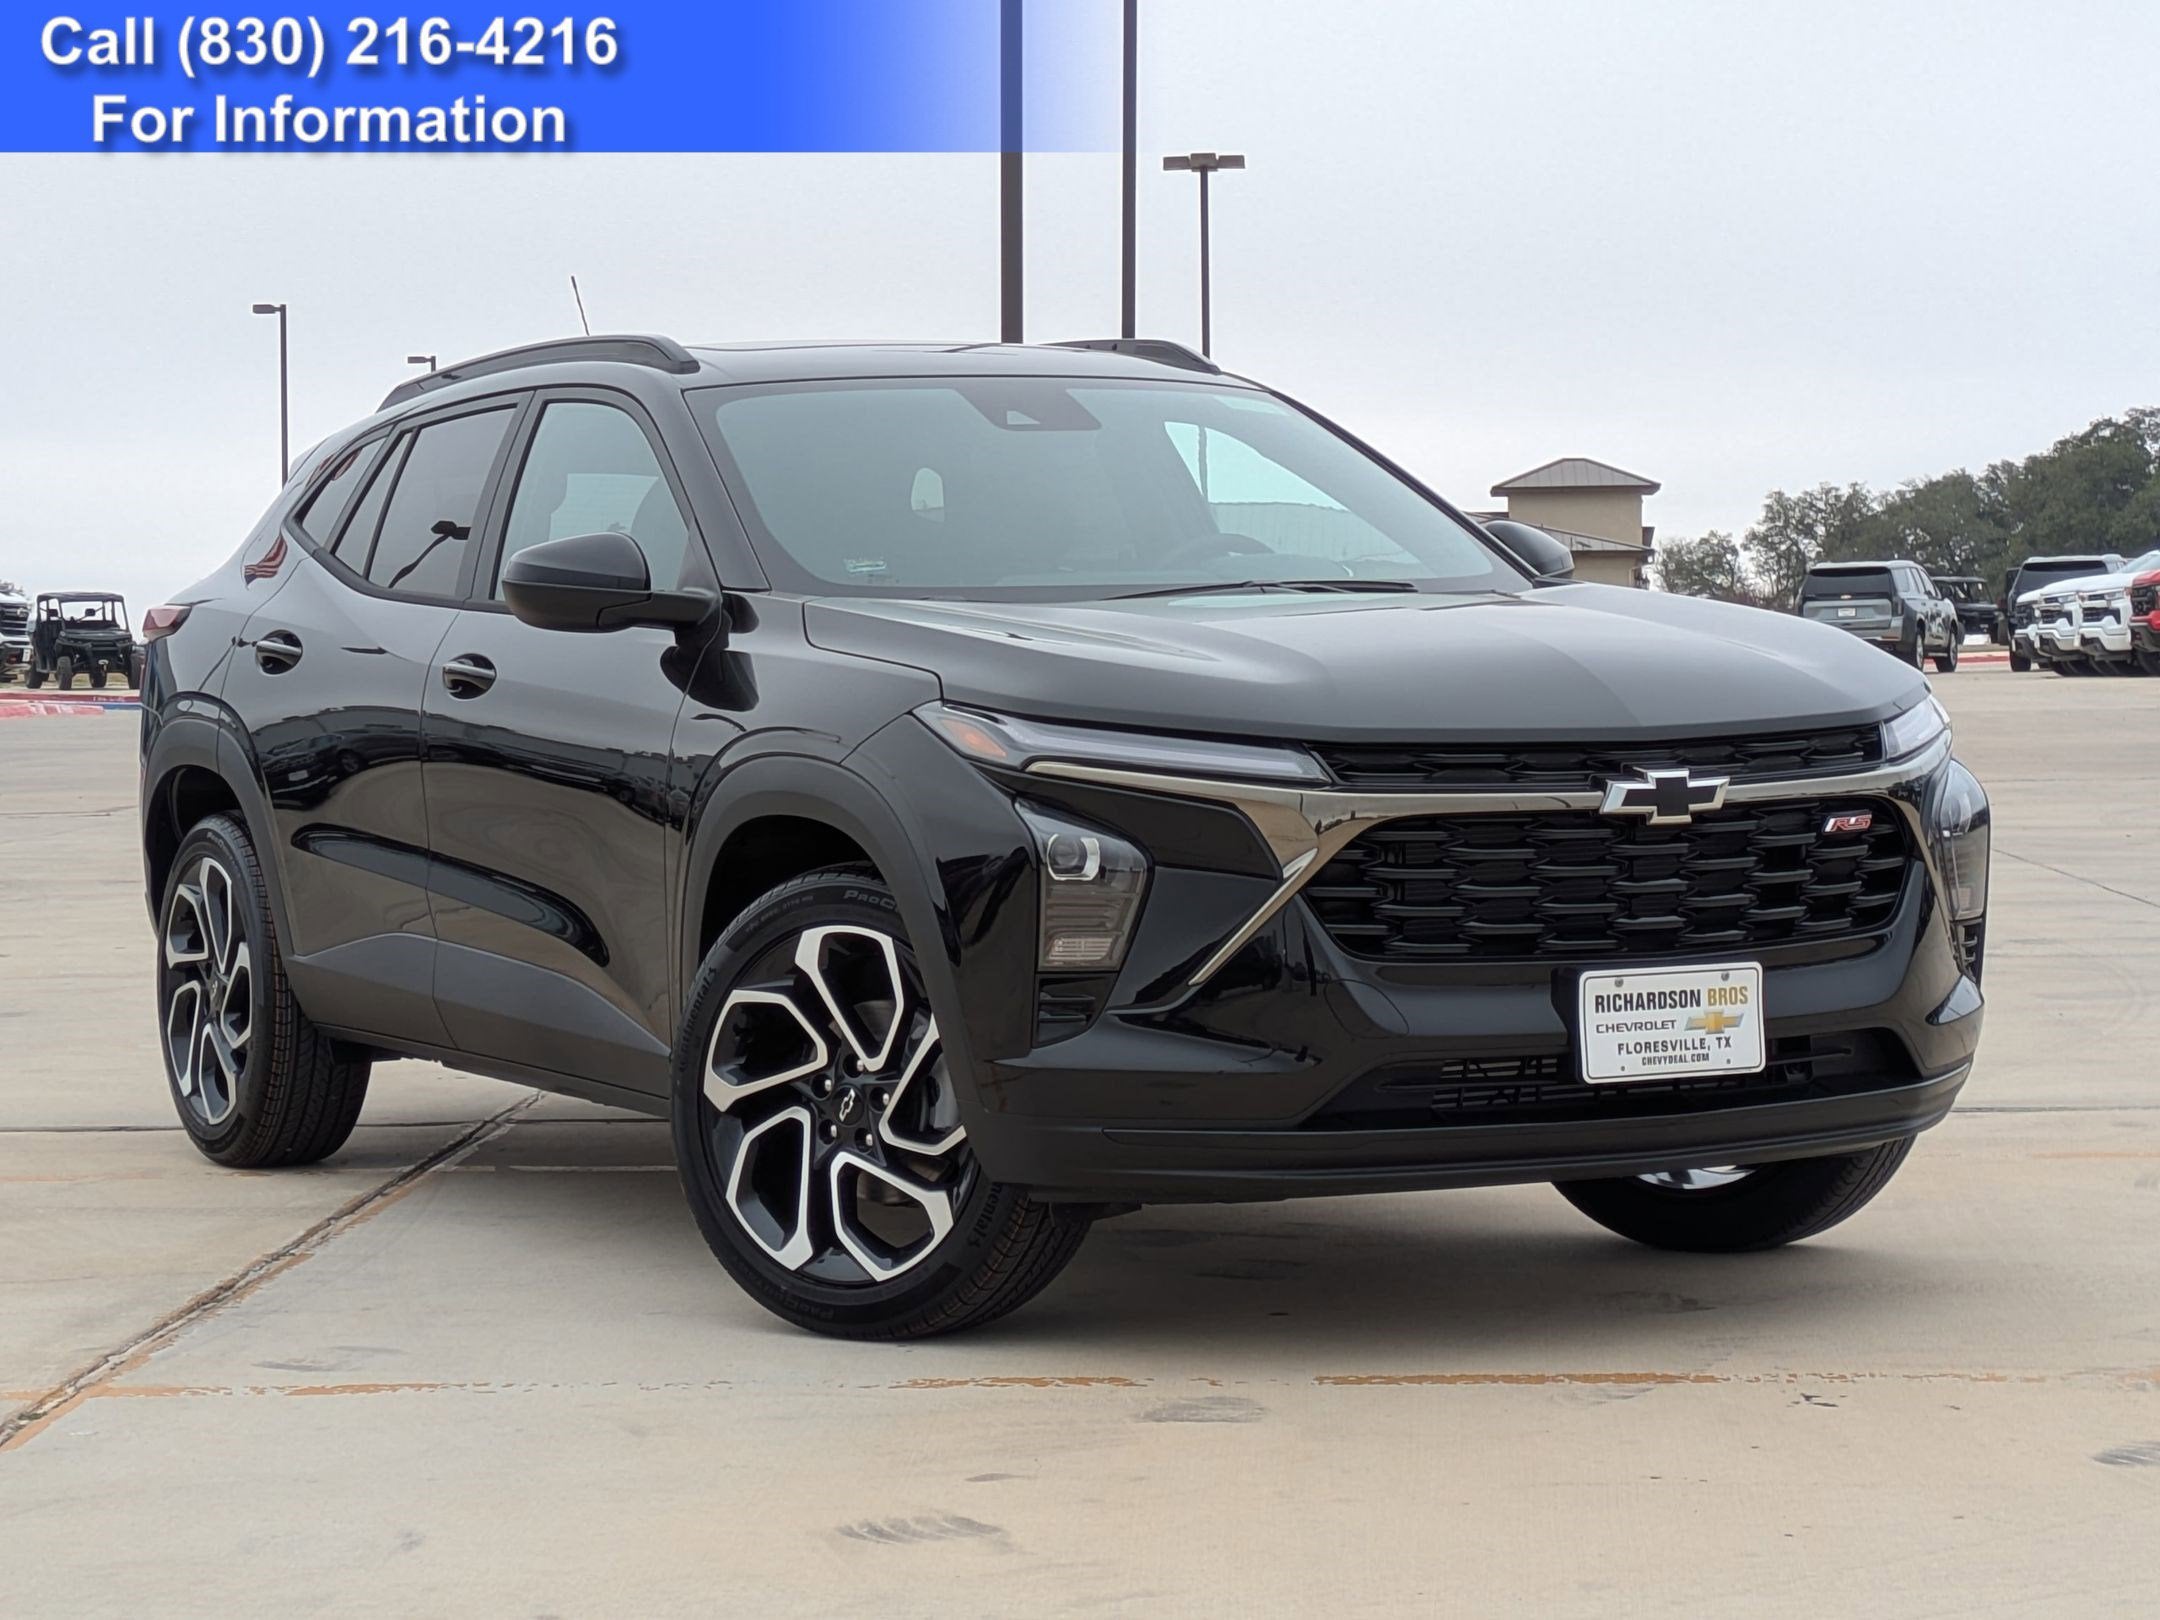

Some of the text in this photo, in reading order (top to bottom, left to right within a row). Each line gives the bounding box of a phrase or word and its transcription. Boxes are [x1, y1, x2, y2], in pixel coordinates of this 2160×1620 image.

[1824, 814, 1872, 832] RS
[1594, 986, 1749, 1013] RICHARDSON BROS
[1595, 1019, 1677, 1034] CHEVROLET
[1617, 1036, 1732, 1056] FLORESVILLE, TX
[1641, 1053, 1710, 1066] CHEVYDEAL.COM
